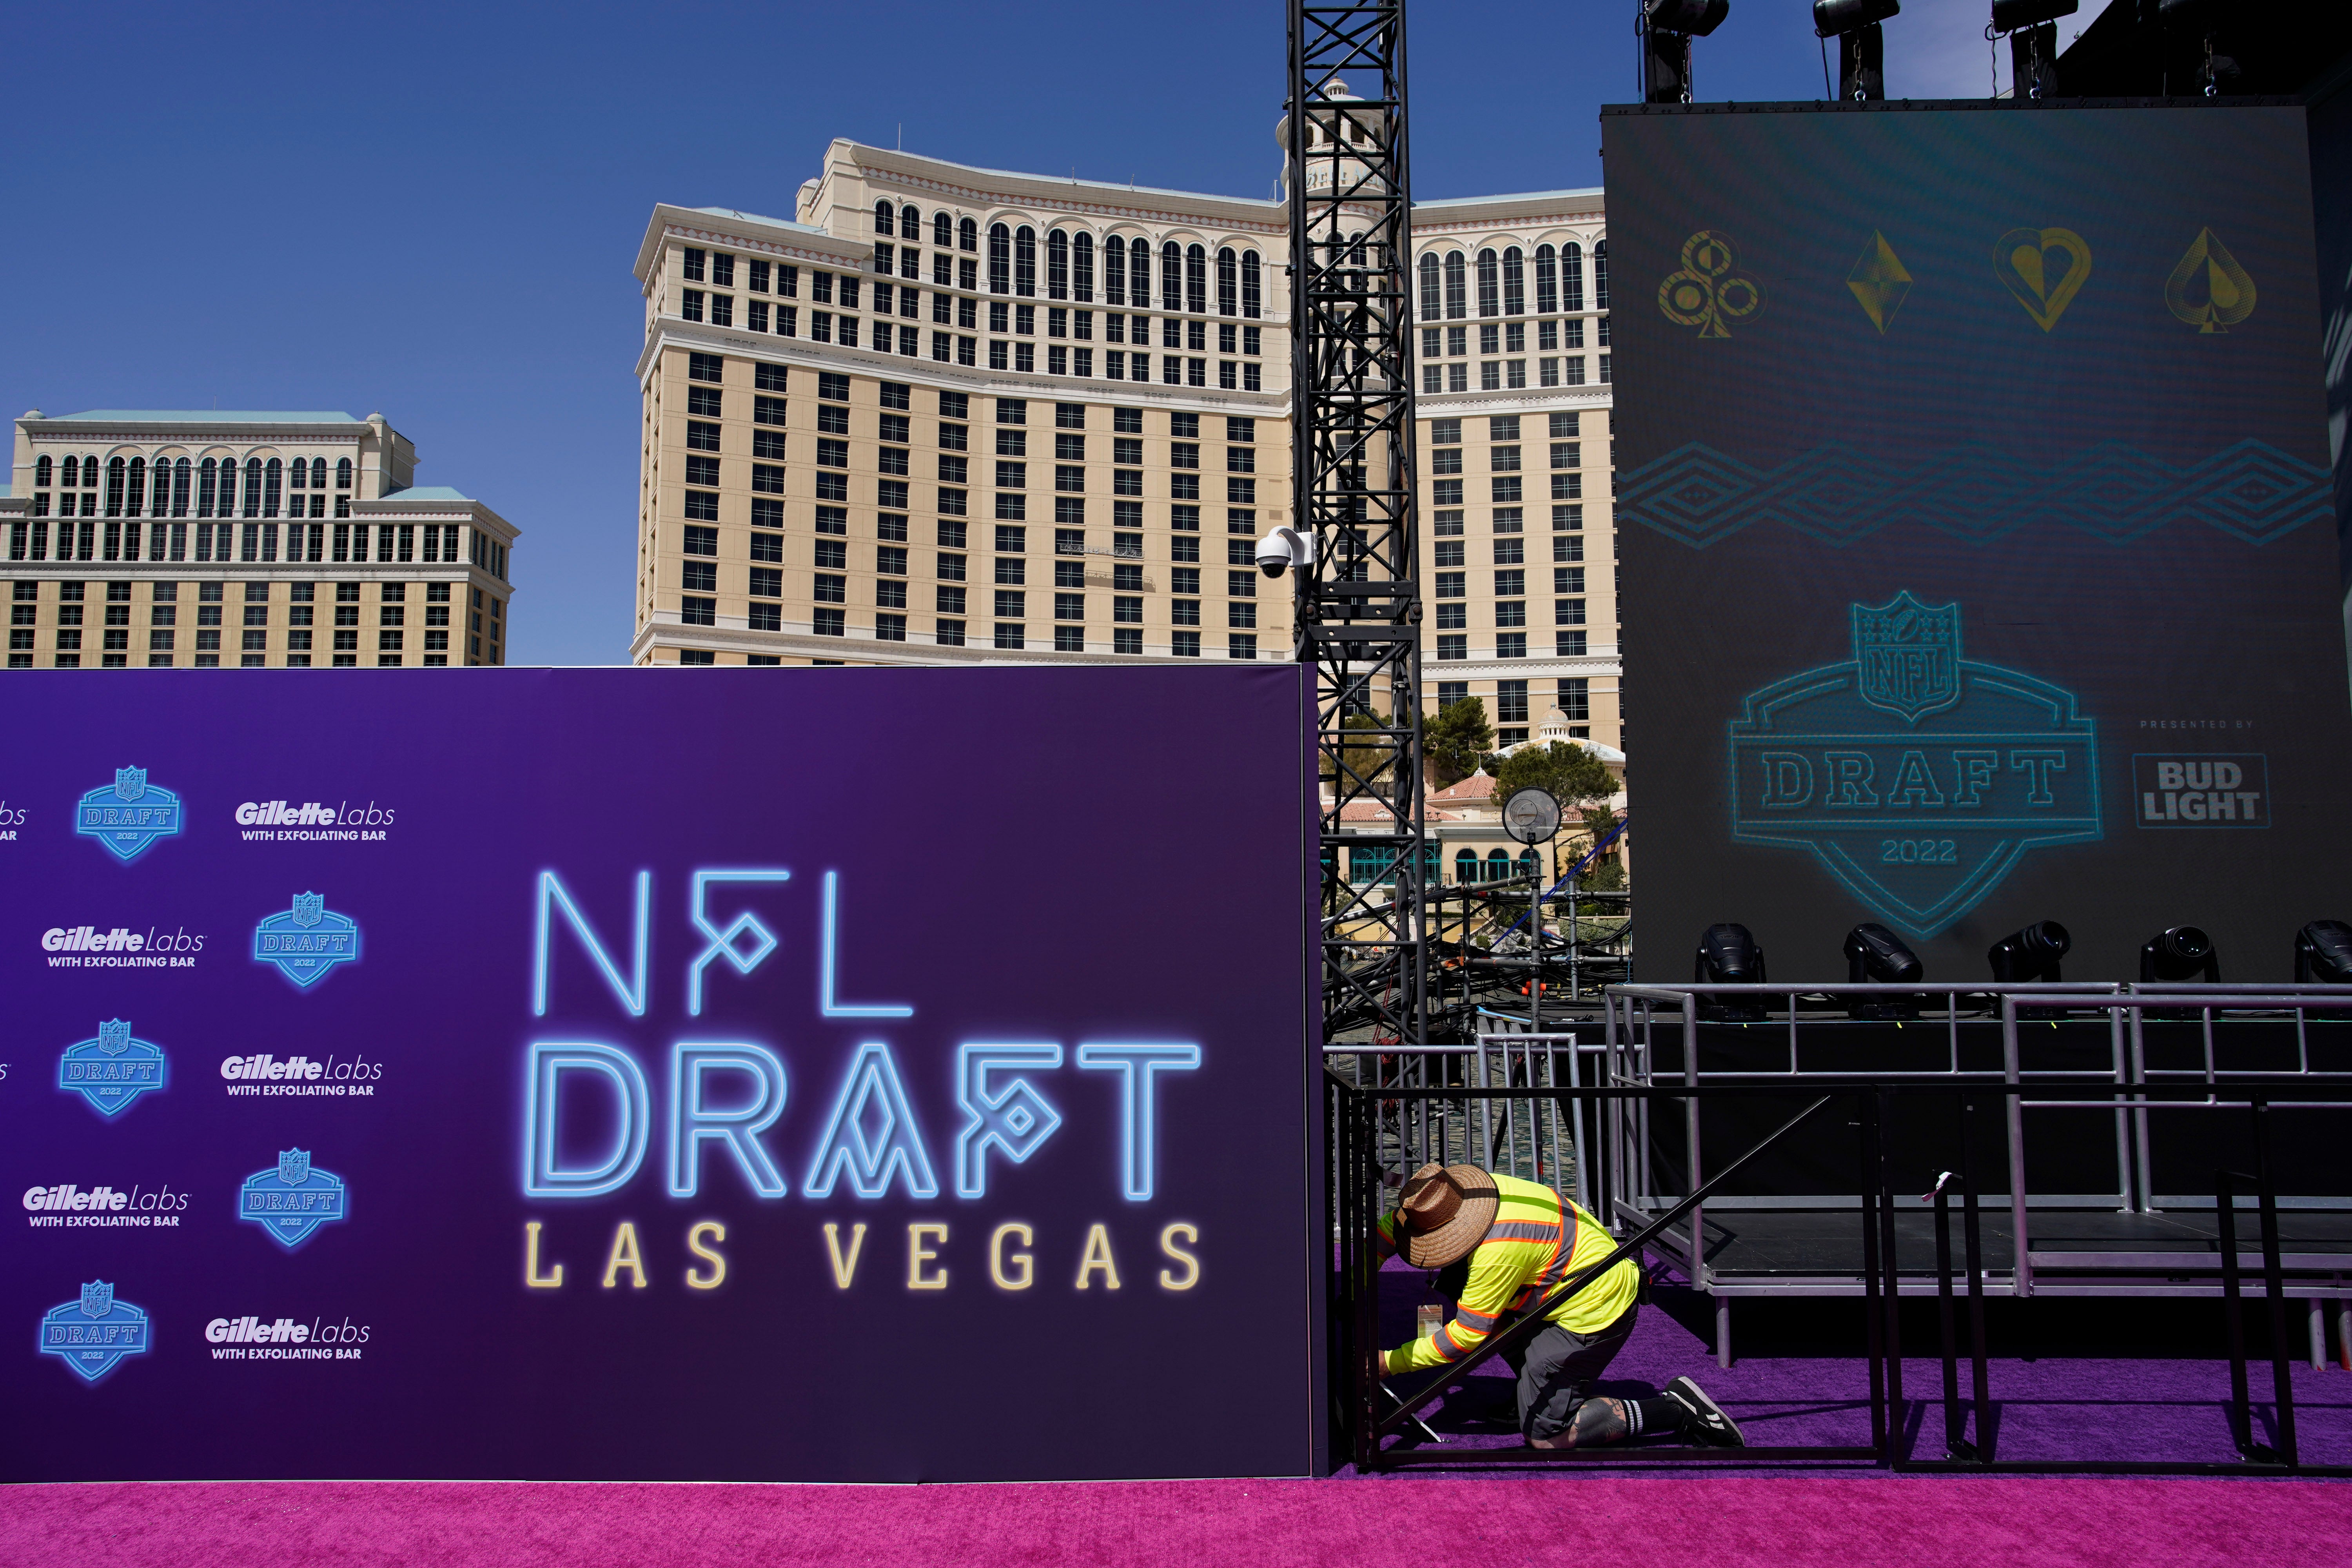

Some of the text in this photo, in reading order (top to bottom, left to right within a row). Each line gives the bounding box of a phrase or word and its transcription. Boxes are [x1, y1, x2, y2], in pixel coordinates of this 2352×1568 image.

[1867, 648, 1950, 704] NFL
[2140, 720, 2227, 729] PRESENTED
[1761, 750, 2065, 806] DRAFT
[2157, 762, 2242, 790] BUD
[119, 781, 141, 796] NFL
[2143, 791, 2260, 821] LIGHT
[86, 809, 171, 825] DRAFT
[241, 831, 387, 840] WITH EXFOLIATING BAR
[1881, 840, 1958, 863] 2022
[296, 907, 318, 922] NFL
[264, 935, 348, 951] DRAFT
[535, 871, 913, 1016] NFL
[48, 957, 195, 967] WITH EXFOLIATING BAR
[103, 1035, 125, 1050] NFL
[69, 1063, 155, 1080] DRAFT
[227, 1085, 374, 1096] WITH EXFOLIATING BAR
[525, 1042, 1201, 1200] DRAFT
[283, 1165, 305, 1180] NFL
[250, 1193, 335, 1210] DRAFT
[29, 1216, 179, 1227] WITH EXFOLIATING BAR
[526, 1221, 1200, 1290] LAS VEGAS
[85, 1297, 107, 1313] NFL
[50, 1326, 138, 1344] DRAFT
[212, 1349, 361, 1359] WITH EXFOLIATING BAR
